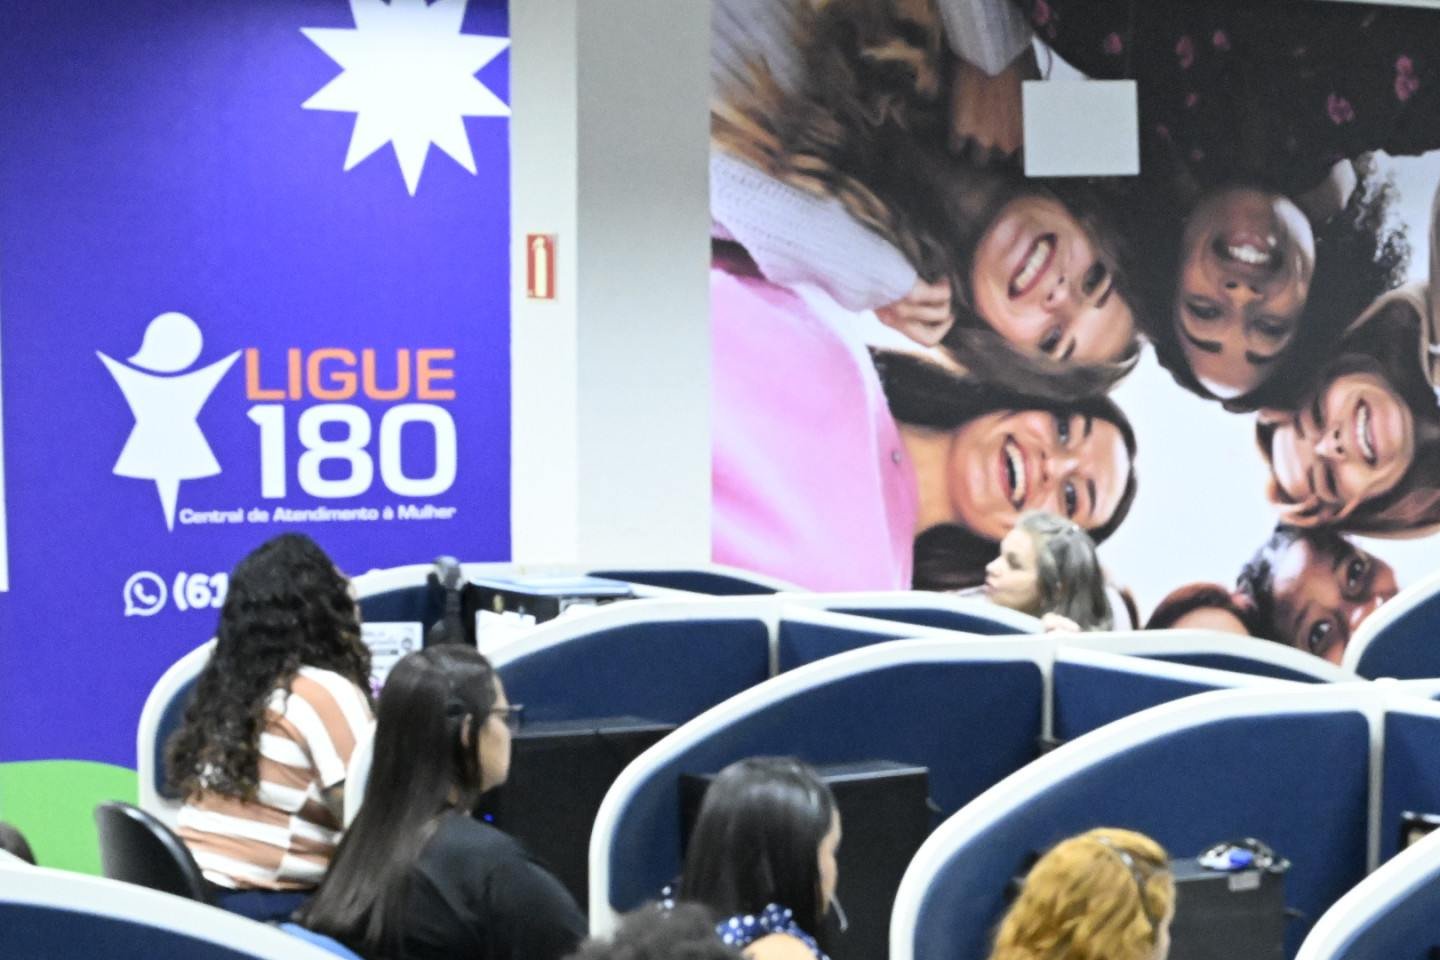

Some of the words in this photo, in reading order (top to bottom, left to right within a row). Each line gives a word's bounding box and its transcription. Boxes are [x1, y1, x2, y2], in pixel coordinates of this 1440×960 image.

[245, 348, 457, 400] LIGUE
[246, 403, 458, 499] 180
[179, 508, 243, 524] Central
[247, 507, 269, 523] de
[273, 505, 379, 523] Atendimento
[397, 504, 457, 520] Mulher
